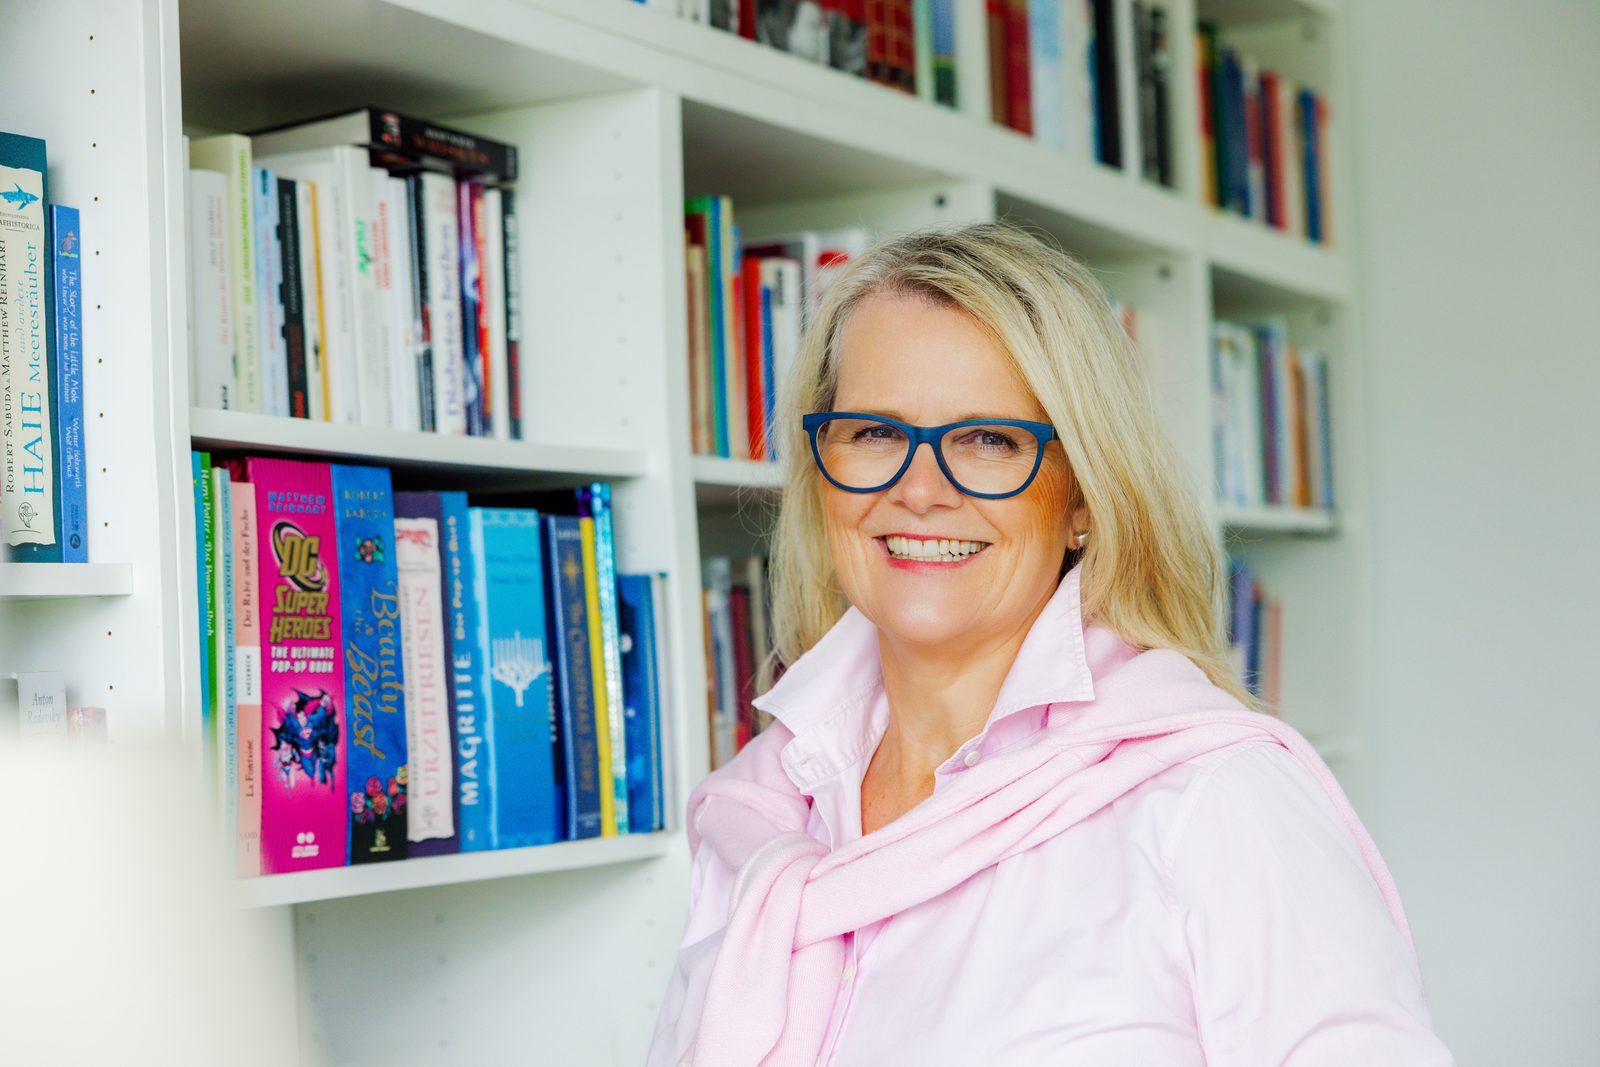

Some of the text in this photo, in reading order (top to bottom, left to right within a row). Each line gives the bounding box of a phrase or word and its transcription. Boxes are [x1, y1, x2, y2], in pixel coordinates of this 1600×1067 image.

[14, 280, 26, 353] und andere
[24, 242, 40, 382] Meeresräuber
[0, 308, 10, 377] MATTHEW
[69, 270, 81, 404] The Story of the Little Mole
[4, 385, 13, 437] SABUDA
[20, 392, 44, 496] HAIE
[65, 427, 73, 446] Wolf
[72, 417, 80, 447] Werner
[6, 441, 14, 493] ROBERT
[200, 469, 210, 500] Harry
[268, 491, 325, 504] MATTHEW
[203, 502, 212, 533] Potter
[242, 541, 251, 557] der
[280, 534, 321, 578] DC
[242, 559, 251, 576] und
[242, 581, 252, 606] Rabe
[272, 584, 329, 616] SUPER
[243, 609, 252, 628] Der
[269, 616, 334, 645] HEROES
[271, 646, 335, 660] THE ULTIMATE
[371, 580, 405, 714] Beauty
[271, 660, 334, 674] POP-UP BOOK
[32, 692, 54, 706] Anton
[346, 641, 386, 760] Beast
[415, 587, 440, 797] URZEITRIESEN
[453, 652, 482, 806] MAGRITTE
[244, 740, 255, 798] La Fontaine
